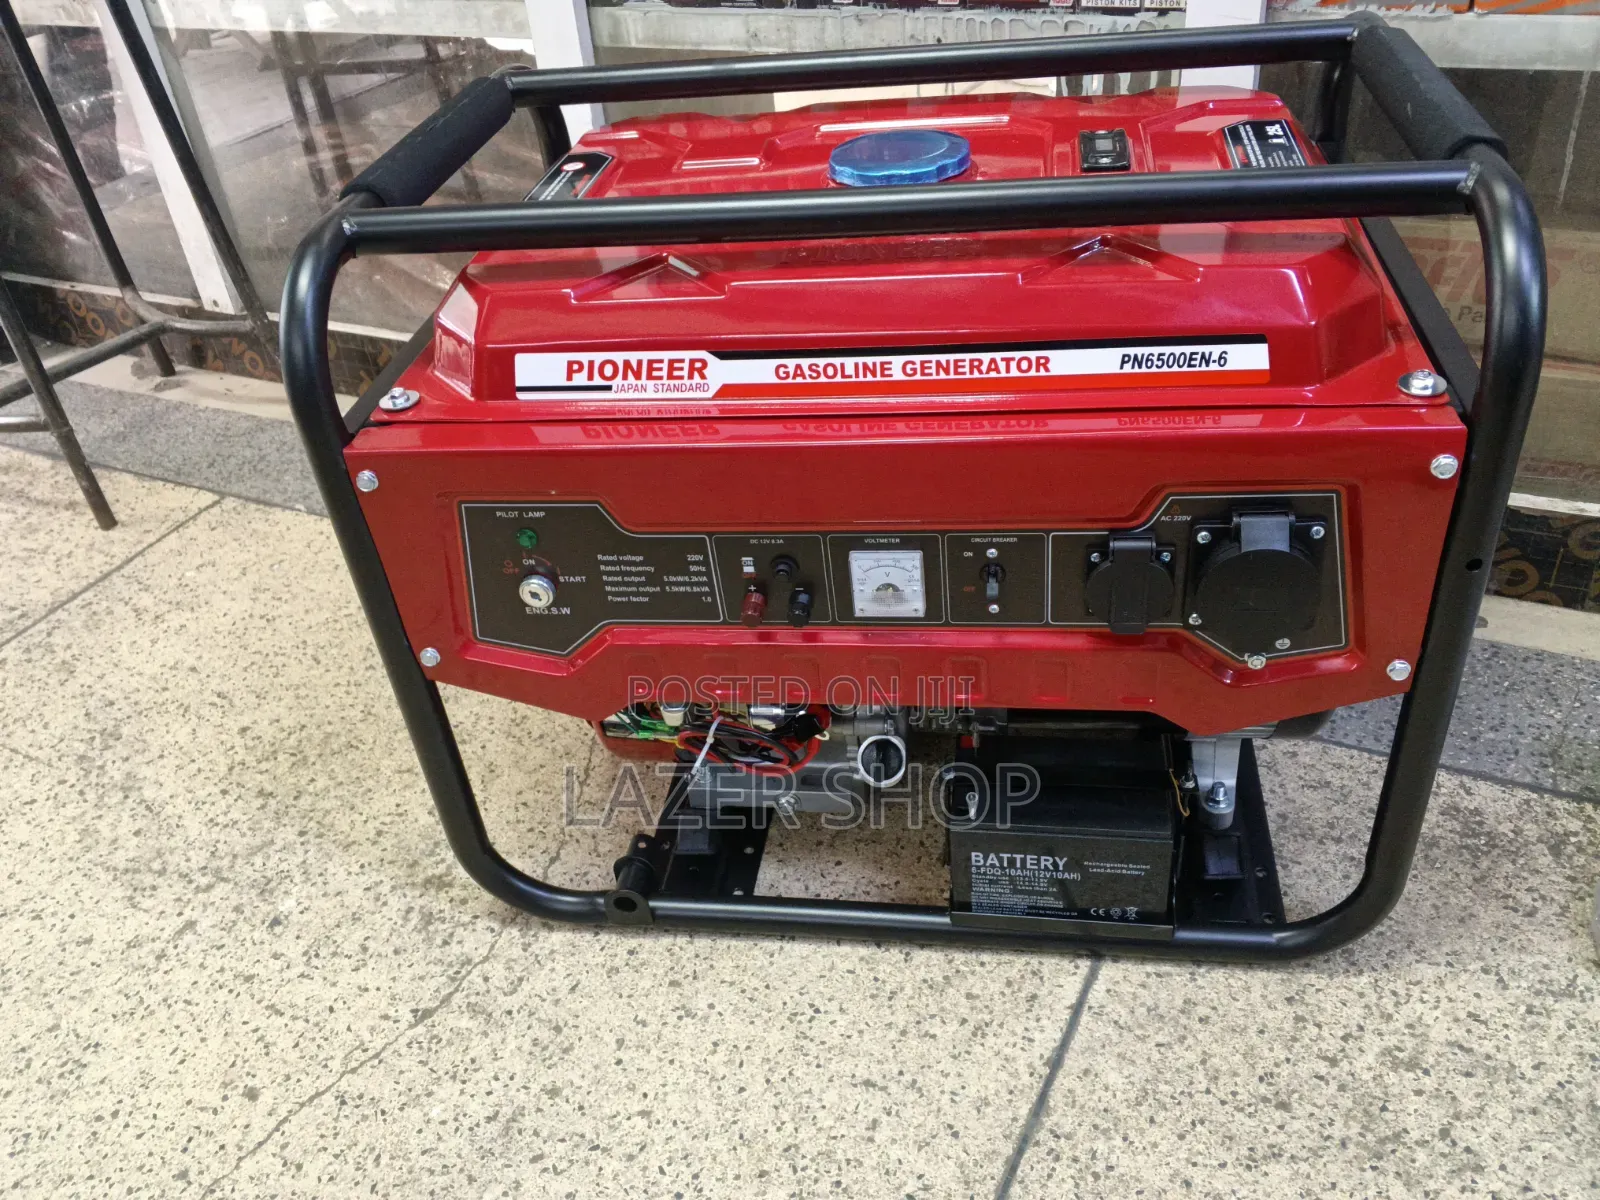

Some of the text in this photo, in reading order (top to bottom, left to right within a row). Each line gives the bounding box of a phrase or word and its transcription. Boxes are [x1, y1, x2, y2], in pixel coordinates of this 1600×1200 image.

[1119, 351, 1228, 371] PN6500EN-6
[565, 357, 709, 382] PIONEER
[774, 355, 1051, 381] GASOLINE GENERATOR
[613, 382, 710, 394] JAPAN STANDARD
[522, 558, 536, 566] ON
[619, 554, 644, 562] voltage
[621, 564, 655, 573] frequency
[623, 575, 646, 583] output
[525, 606, 571, 615] ENG.S.W
[971, 852, 1068, 871] BATTERY
